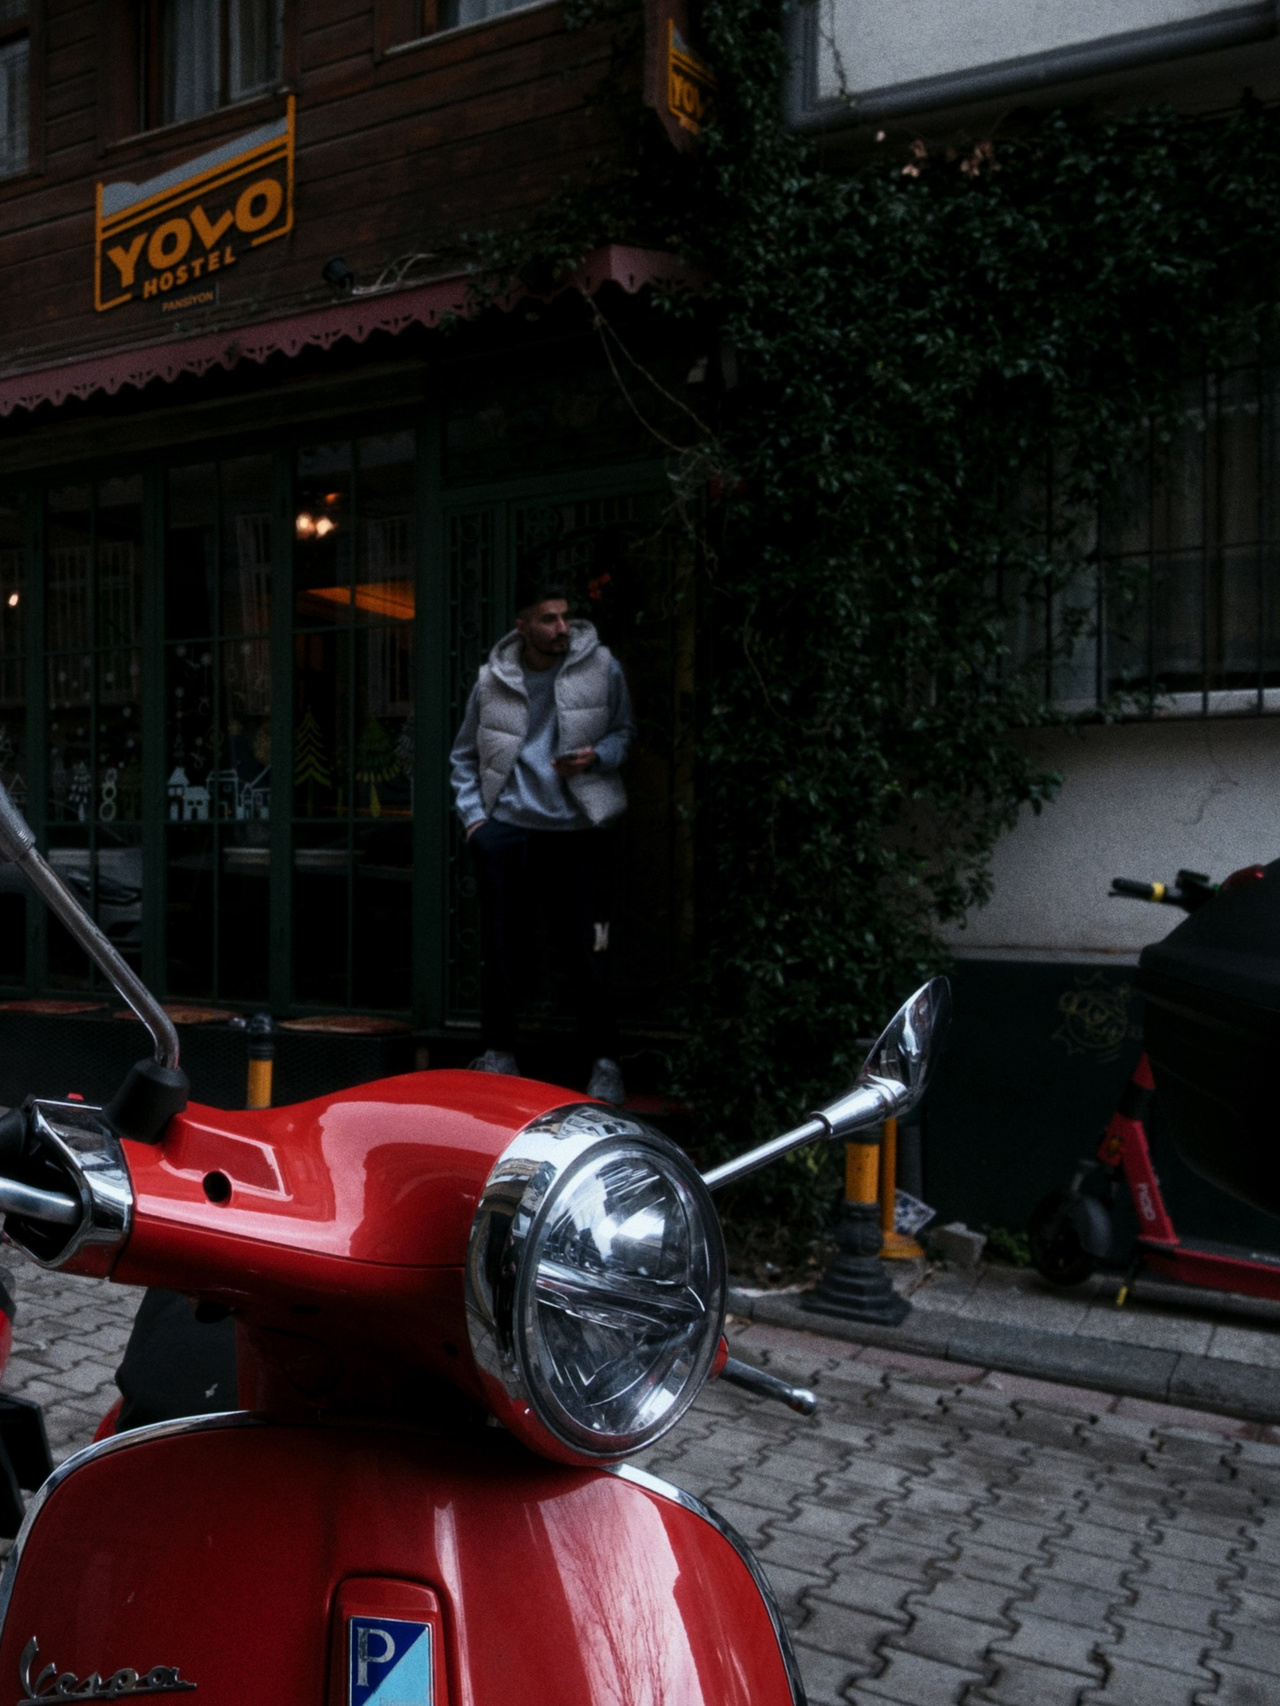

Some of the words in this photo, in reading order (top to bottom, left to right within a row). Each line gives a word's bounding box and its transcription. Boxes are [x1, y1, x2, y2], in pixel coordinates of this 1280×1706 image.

[107, 178, 283, 288] YOLO
[143, 245, 236, 299] HOSTEL
[19, 1635, 197, 1702] Vespa
[356, 1627, 396, 1688] P
